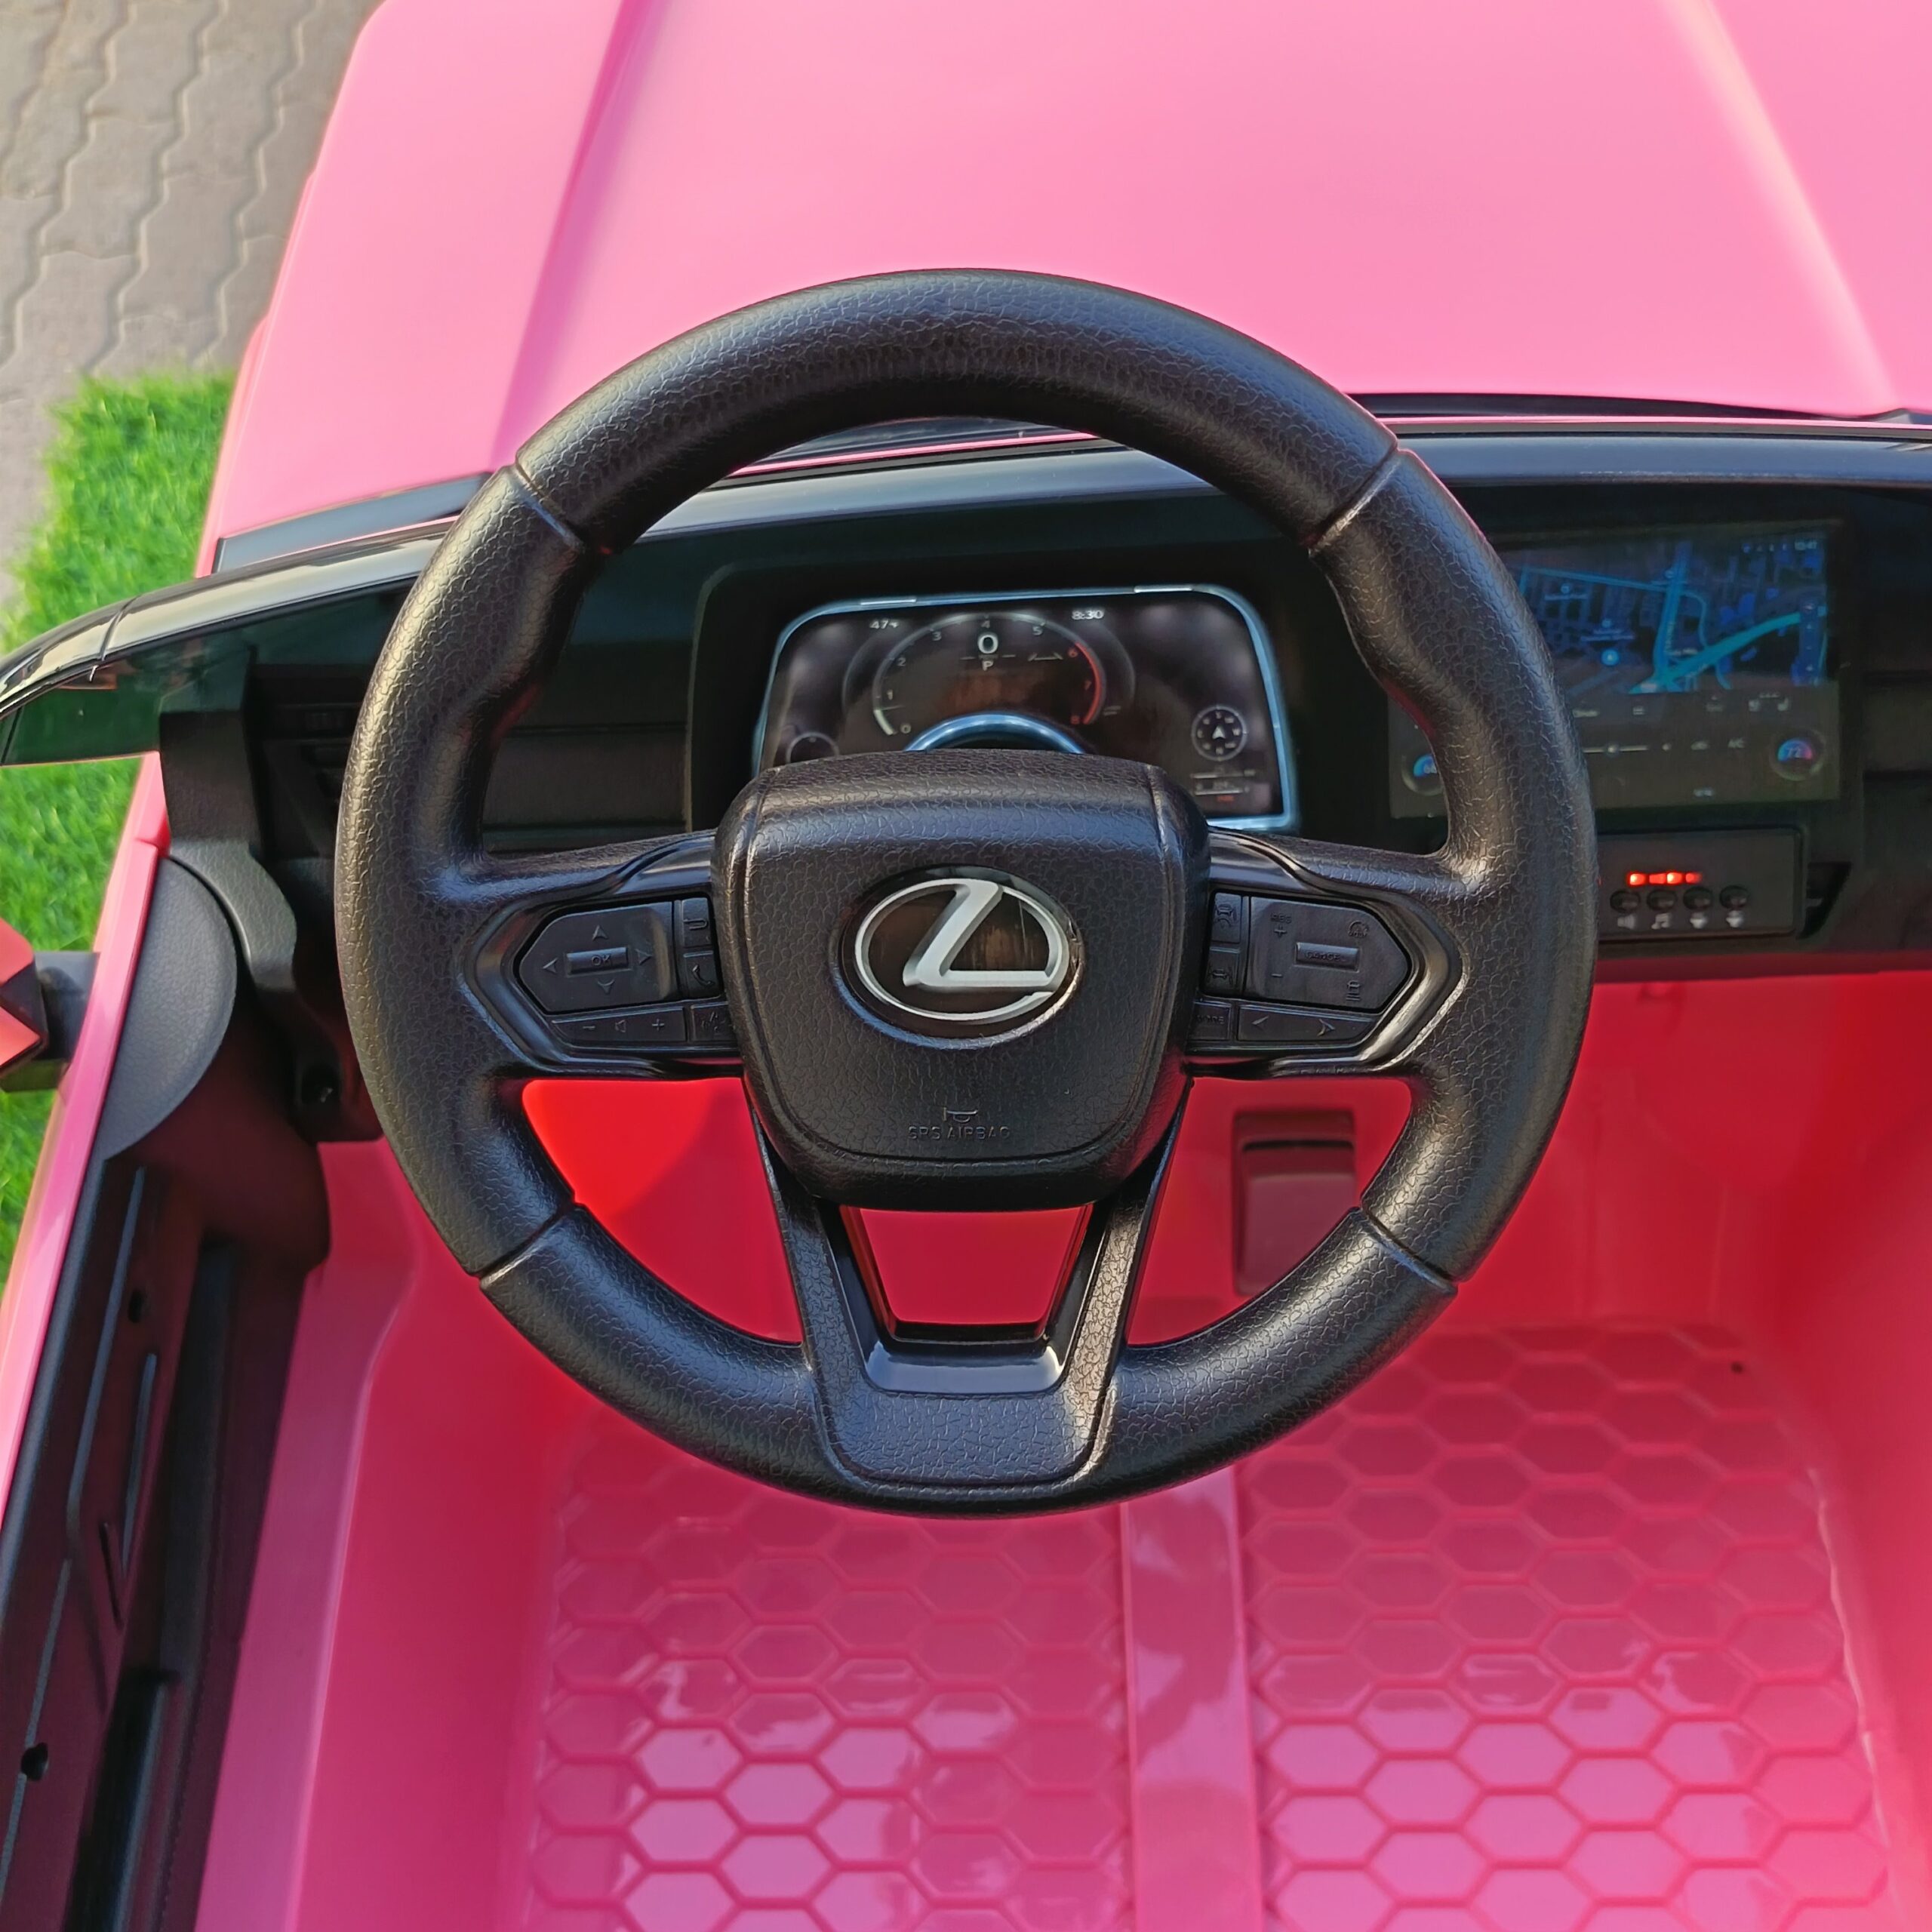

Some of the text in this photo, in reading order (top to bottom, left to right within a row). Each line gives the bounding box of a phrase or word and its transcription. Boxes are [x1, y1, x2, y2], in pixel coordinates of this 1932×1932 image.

[1072, 610, 1104, 620] 8:30
[981, 620, 990, 628] 4
[1032, 626, 1041, 635] 5
[932, 632, 942, 641] 3
[1068, 648, 1078, 657] 6
[897, 657, 906, 667] 2
[982, 660, 994, 671] P
[592, 954, 611, 965] OK
